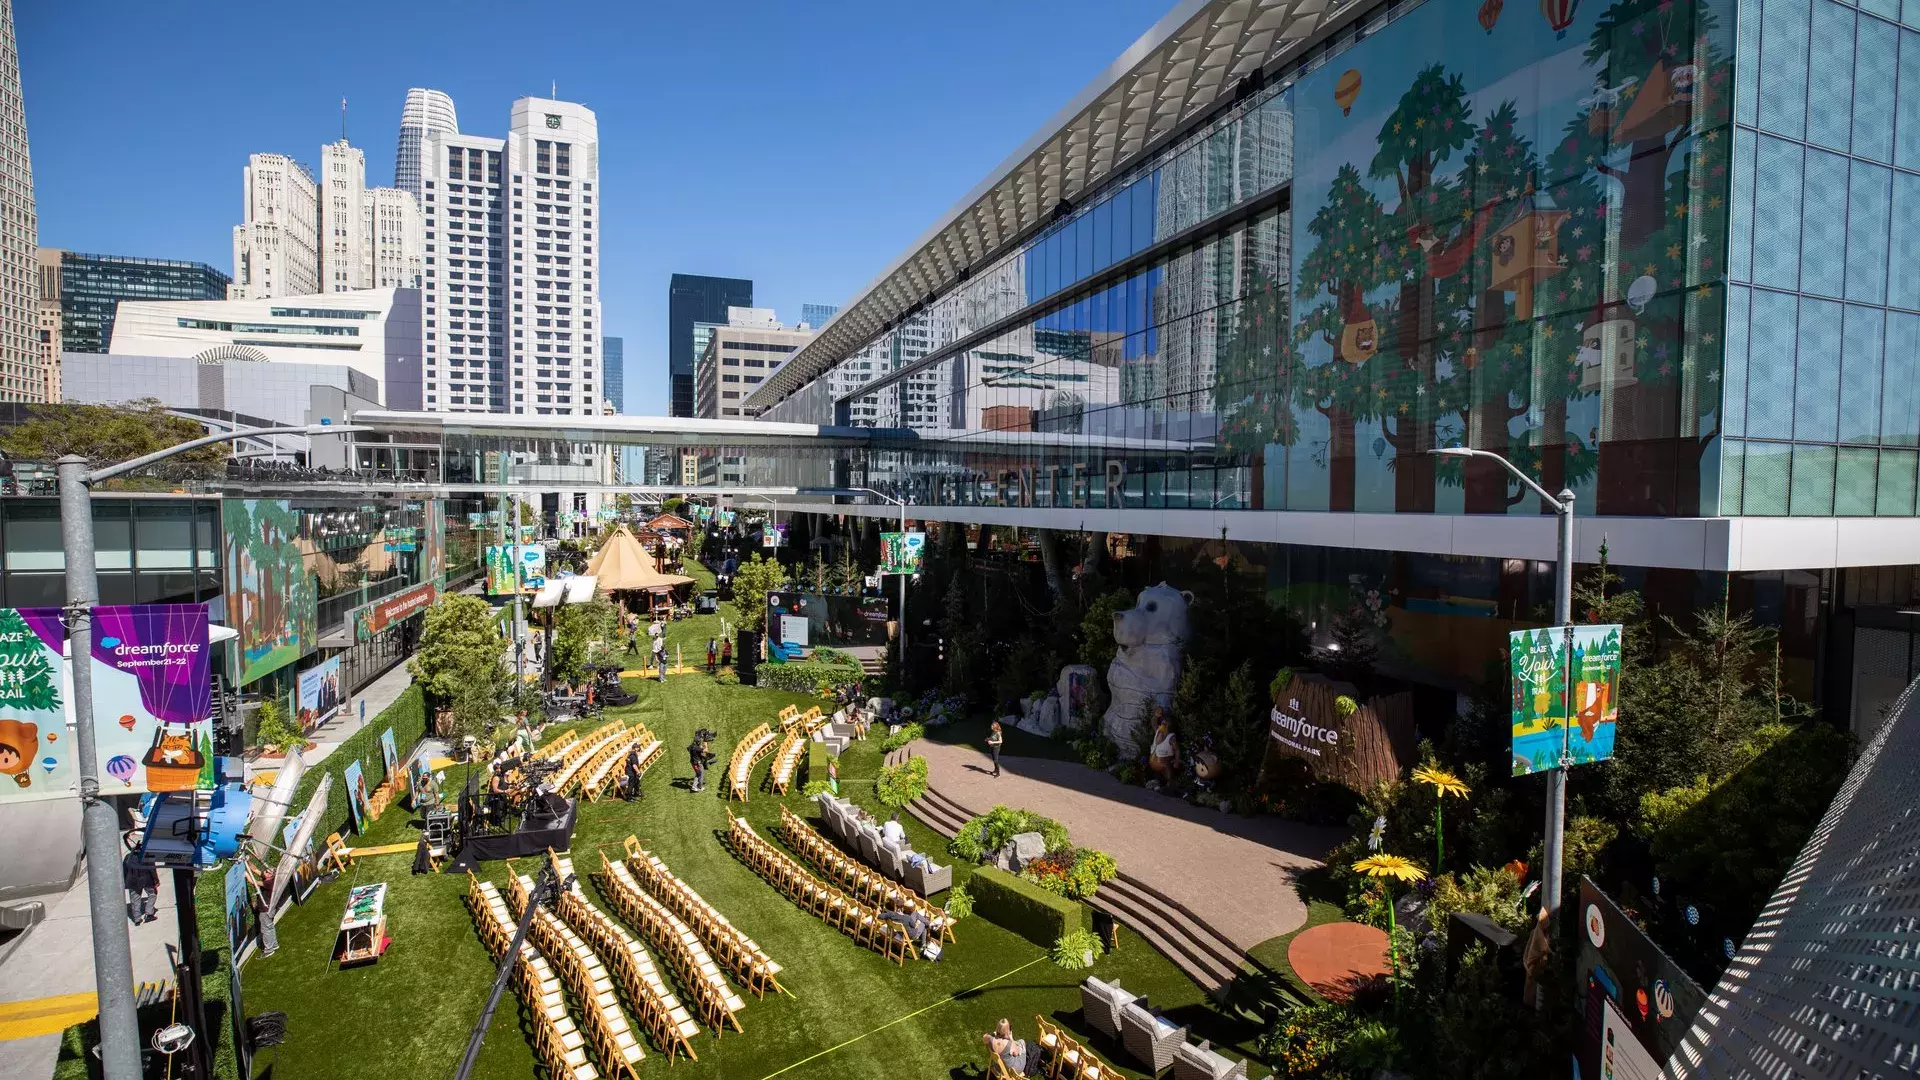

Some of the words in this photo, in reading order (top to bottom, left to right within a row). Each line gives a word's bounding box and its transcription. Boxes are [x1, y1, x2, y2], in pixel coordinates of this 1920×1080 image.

[975, 460, 1125, 508] CENTER
[0, 632, 23, 642] AZE
[115, 642, 199, 657] dreamforce
[1582, 653, 1617, 663] dreamforce
[1519, 654, 1557, 683] Your
[1271, 704, 1338, 745] dreamforce
